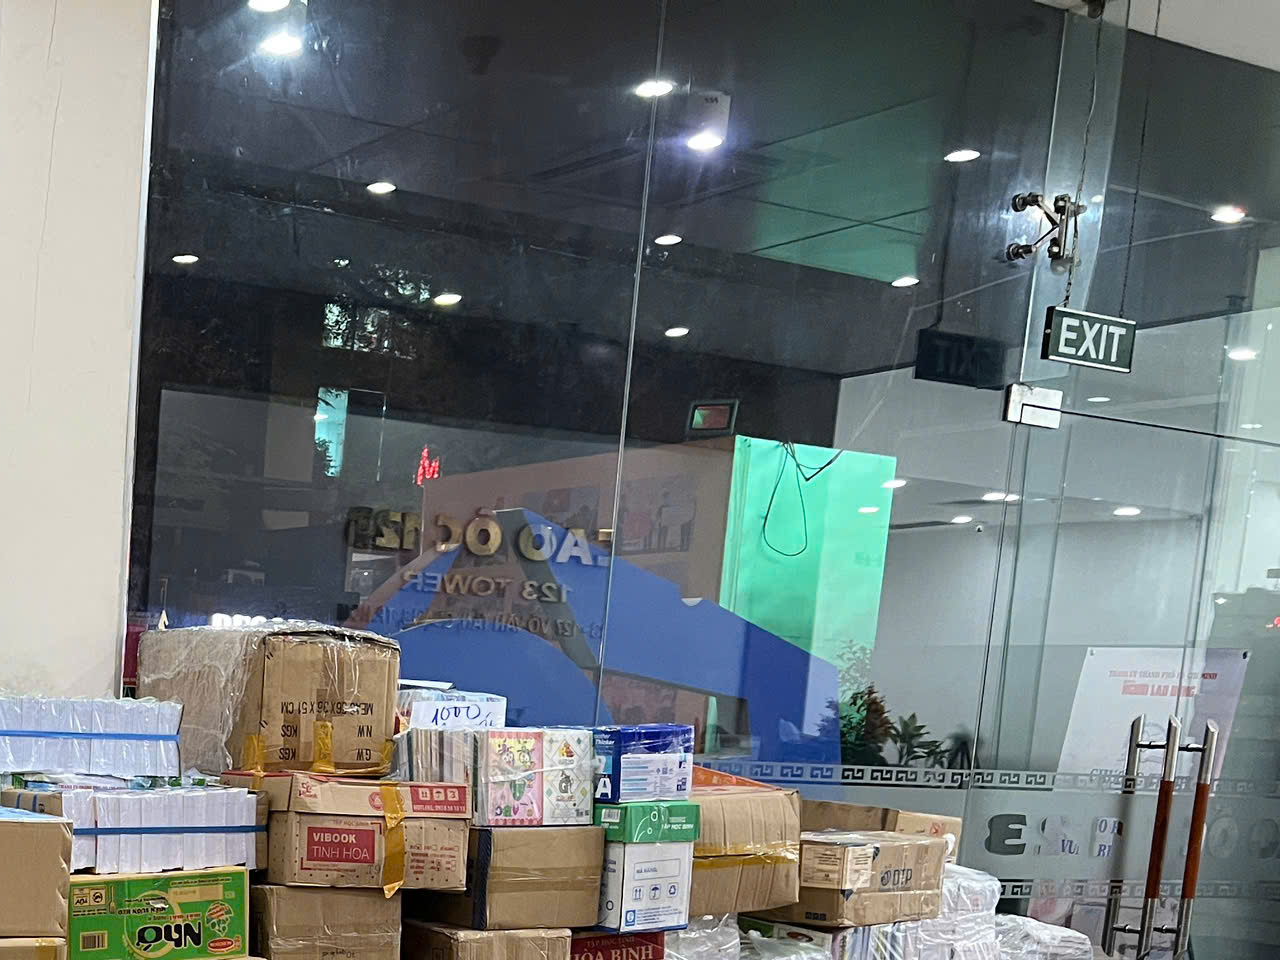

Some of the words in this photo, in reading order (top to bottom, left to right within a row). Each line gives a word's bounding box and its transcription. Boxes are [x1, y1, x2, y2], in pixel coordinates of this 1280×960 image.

[1057, 316, 1127, 364] EXIT
[281, 725, 298, 738] KGS
[279, 748, 297, 761] KGS
[312, 832, 356, 844] VIBOOK
[312, 846, 340, 858] TINH
[343, 847, 370, 860] HOA
